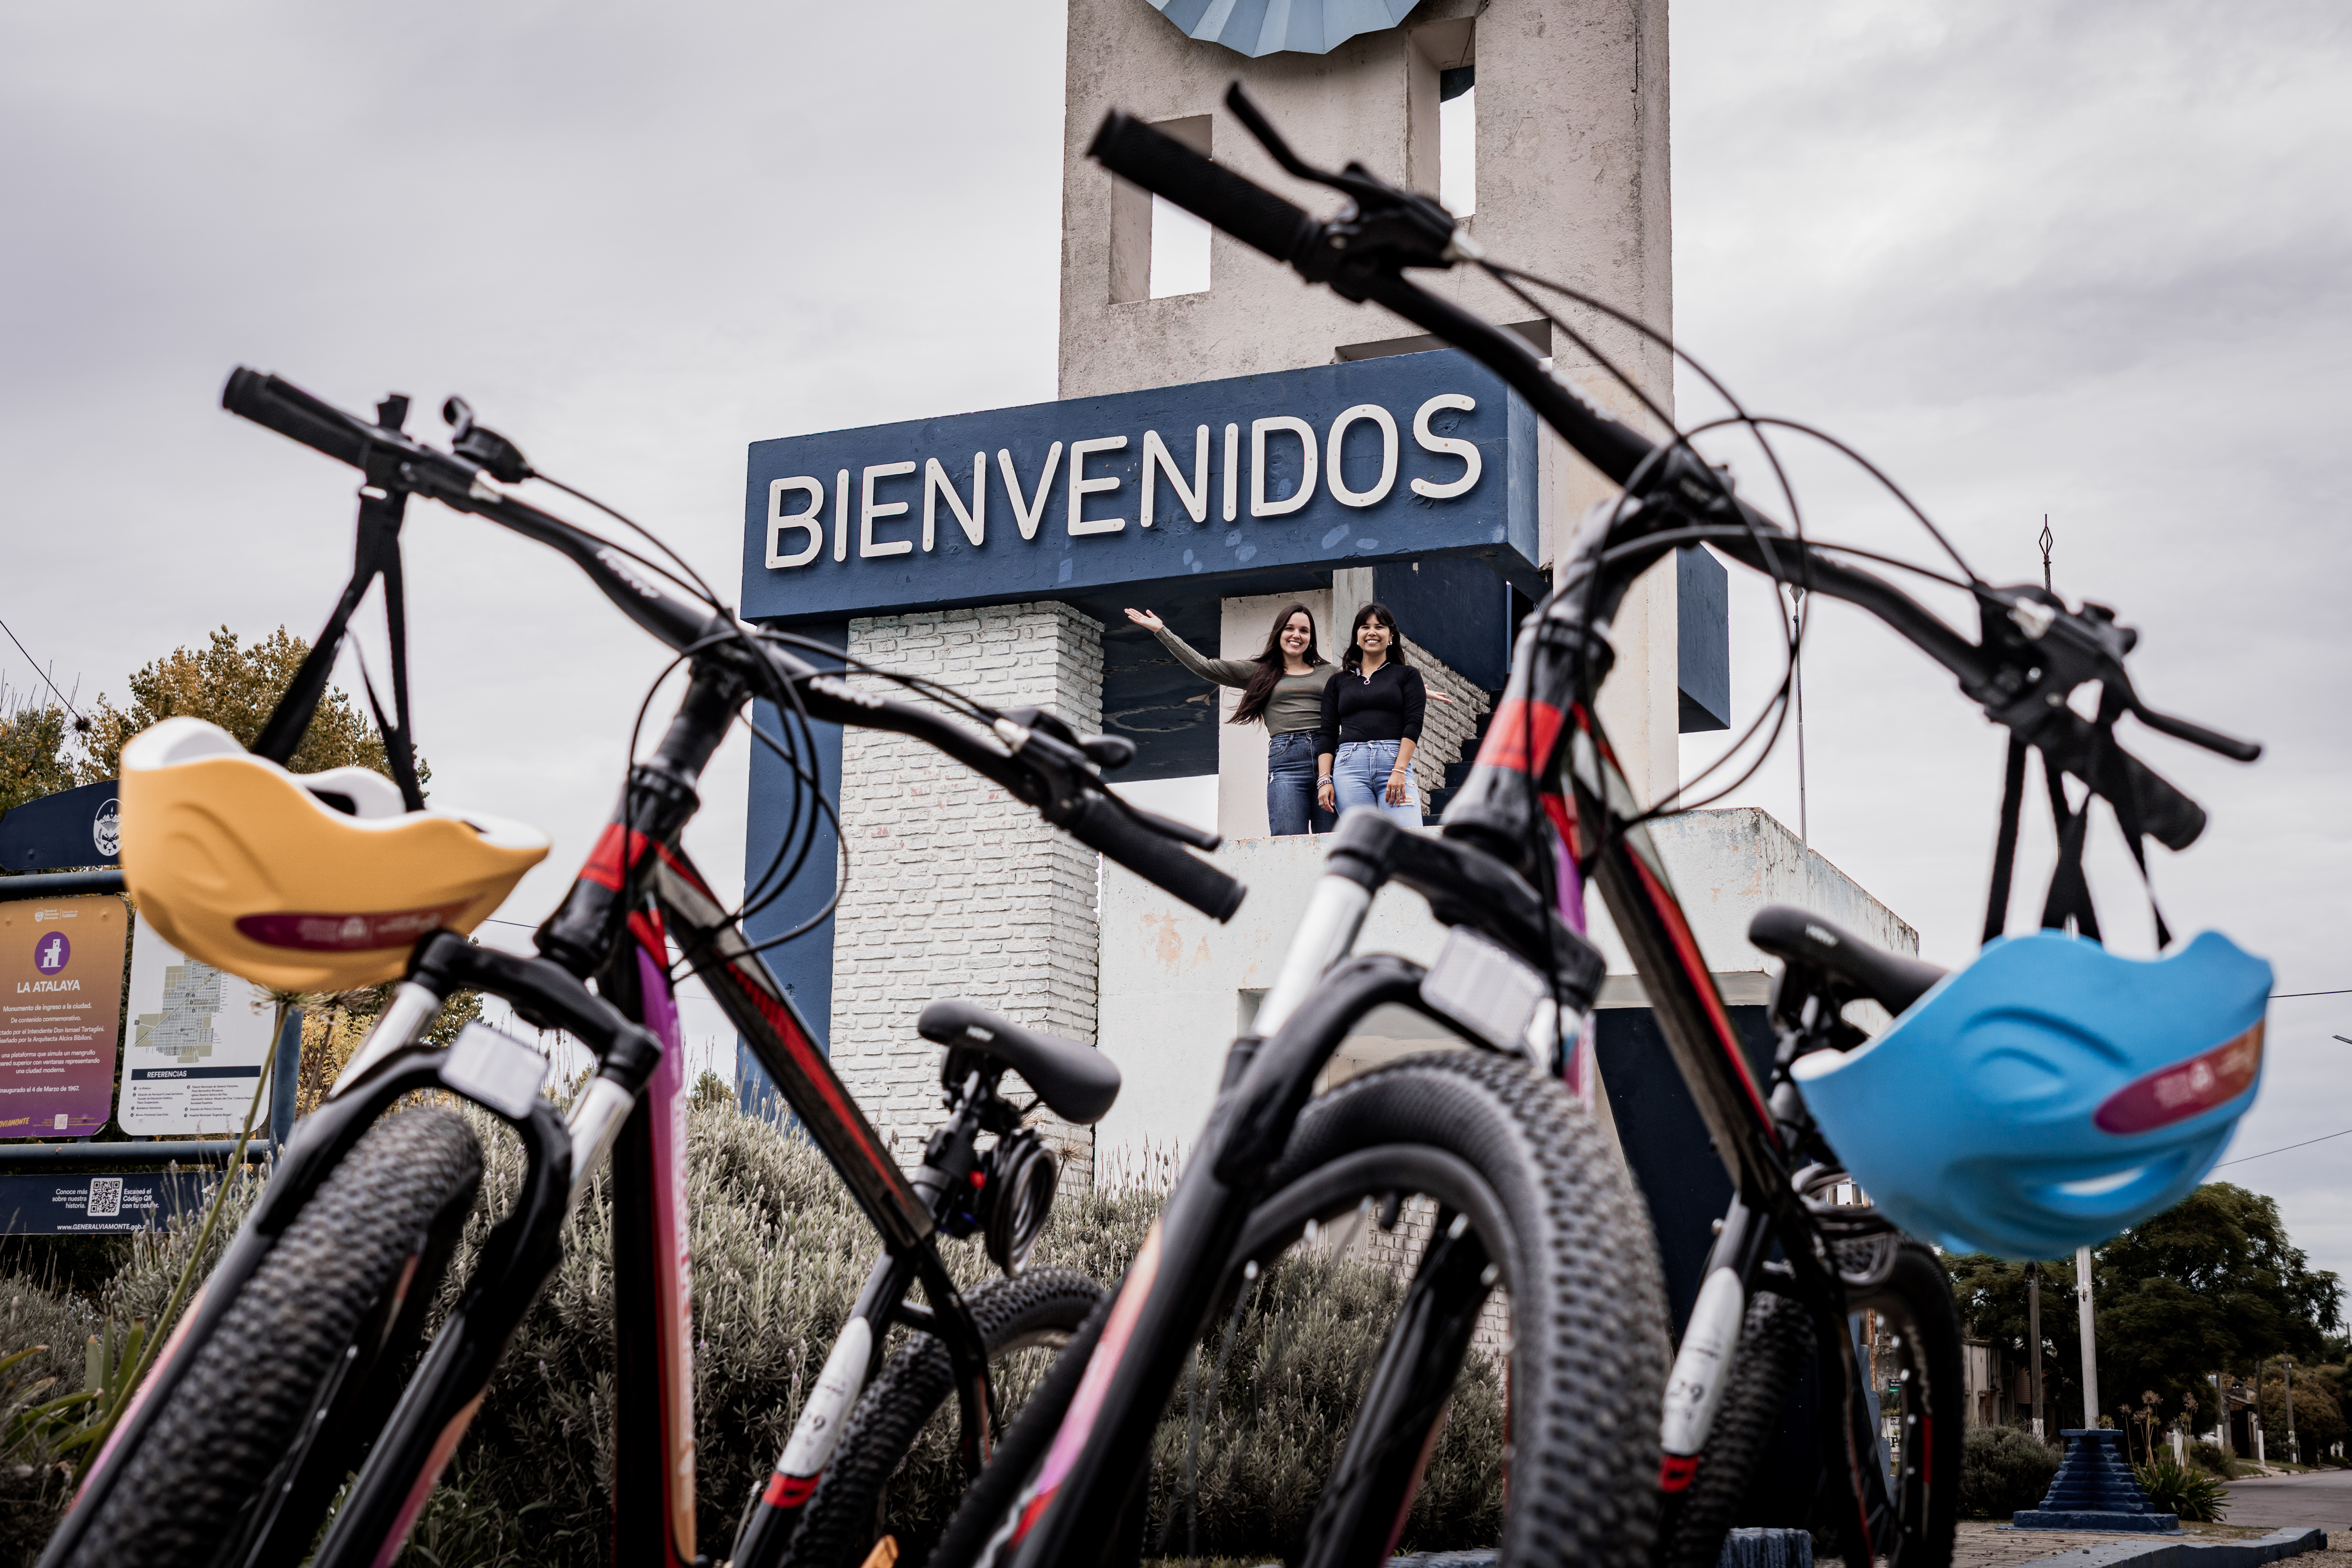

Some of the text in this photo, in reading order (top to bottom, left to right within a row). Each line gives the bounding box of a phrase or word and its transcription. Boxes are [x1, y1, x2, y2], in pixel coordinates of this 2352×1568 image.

[765, 393, 1482, 570] BIENVENIDOS
[17, 979, 80, 993] LA ATALAYA
